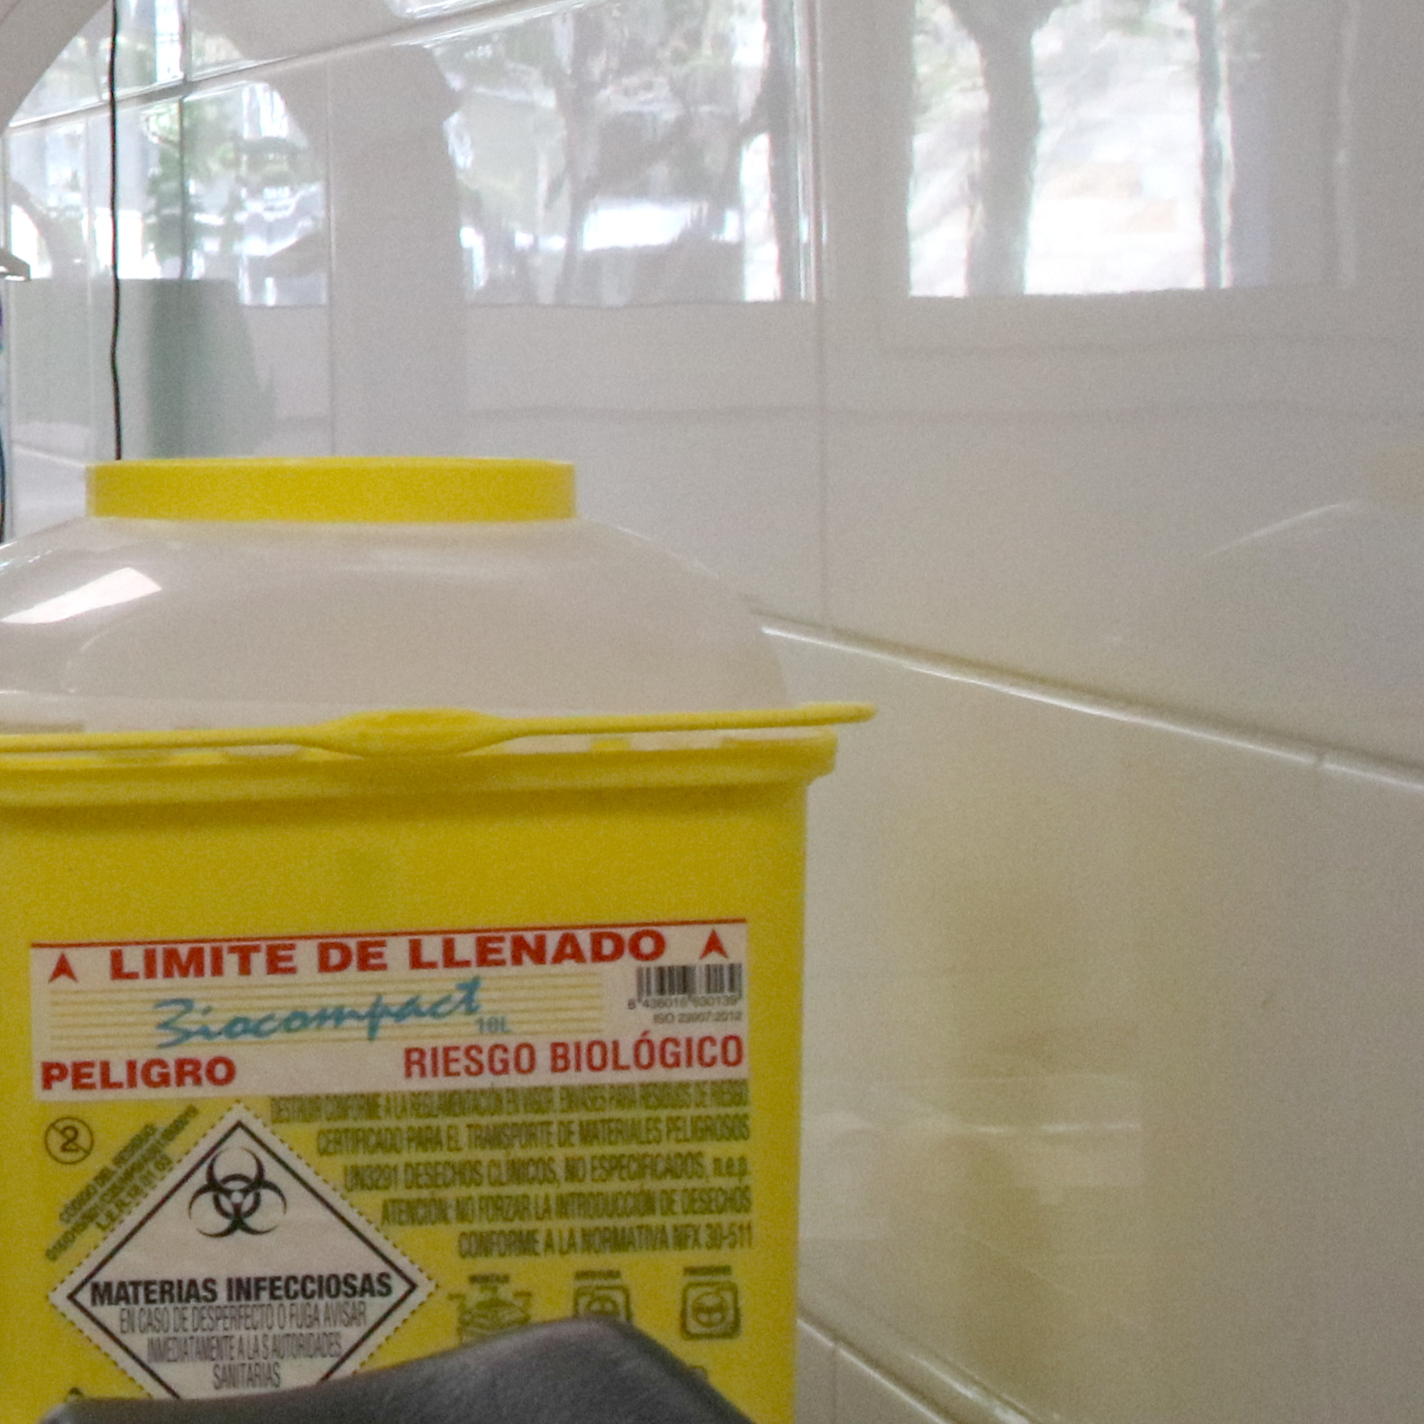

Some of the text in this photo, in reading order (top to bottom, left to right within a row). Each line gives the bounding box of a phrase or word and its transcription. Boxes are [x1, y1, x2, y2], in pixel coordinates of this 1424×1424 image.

[109, 929, 667, 981] LIMITE DE LLENADO
[154, 975, 483, 1049] Biocompact
[653, 1013, 675, 1024] ISO
[404, 1030, 745, 1079] RIESGO BIOLÓGICO
[41, 1056, 237, 1091] PELIGRO
[317, 1113, 750, 1156] CERTIFICADO PARA EL TRANSPORTE DE MATERIALES PELIGROSOS
[343, 1162, 398, 1191] UN3291
[403, 1159, 483, 1189] DESECHOS
[563, 1155, 586, 1184] NO
[454, 1196, 475, 1222] NO
[477, 1194, 531, 1222] FORZAR
[534, 1193, 552, 1220] LA
[659, 1189, 678, 1215] DE
[680, 1186, 750, 1214] DESECHOS
[457, 1229, 539, 1259] CONFORME
[543, 1228, 555, 1256] A
[557, 1227, 578, 1256] LA
[580, 1225, 669, 1255] NORMATIVA
[703, 1222, 752, 1251] 30-511
[90, 1272, 392, 1307] MATERIAS INFECCIOSAS
[120, 1301, 367, 1333] EN CASO DE DESPERFECTO O FUGA AVISAR
[147, 1335, 235, 1363] INMEDIATAMENTE
[236, 1335, 245, 1360] A
[270, 1332, 342, 1359] AUTORIDADES
[212, 1363, 281, 1391] SANITARIAS
